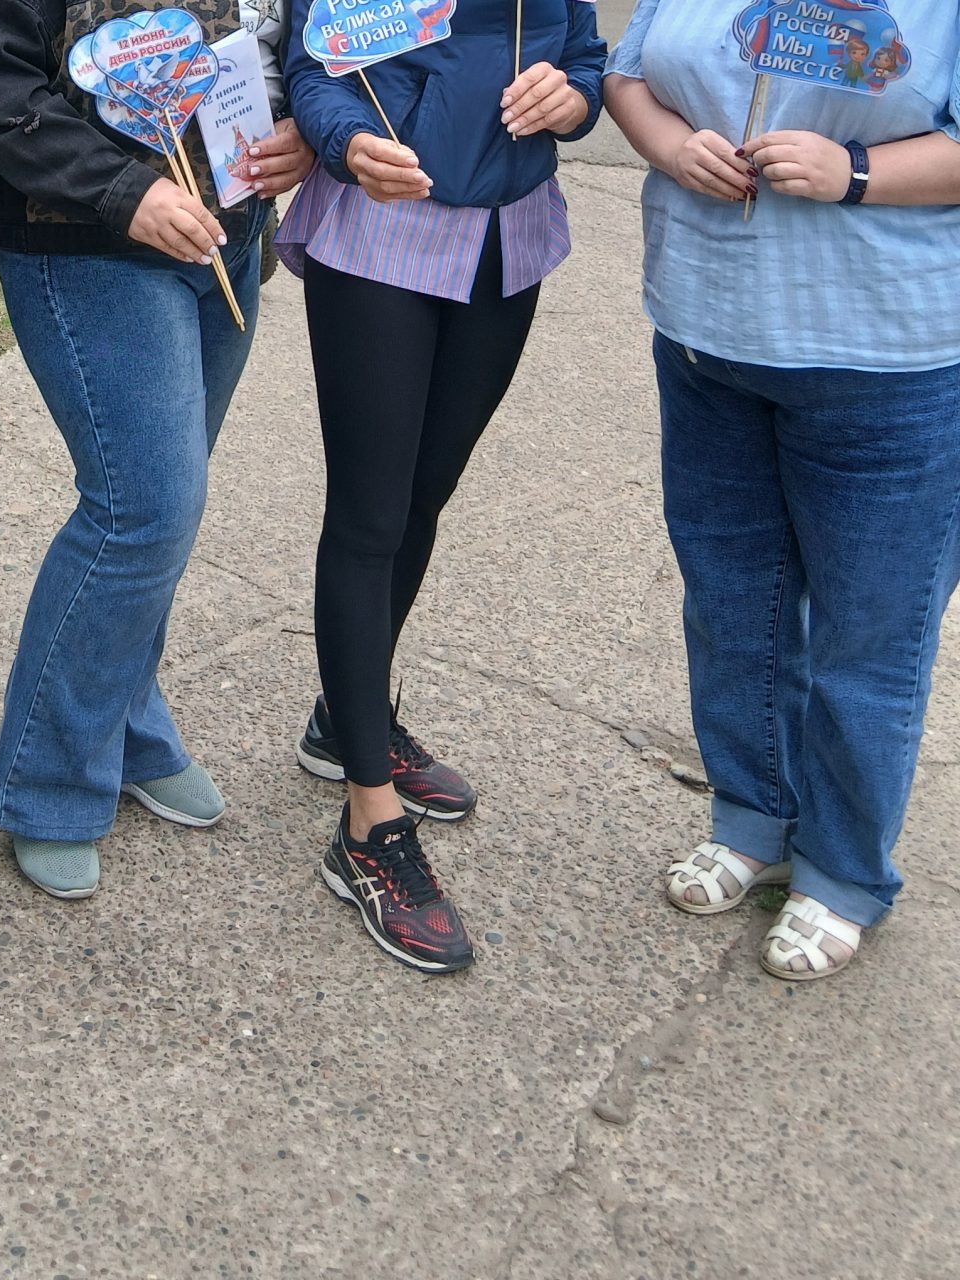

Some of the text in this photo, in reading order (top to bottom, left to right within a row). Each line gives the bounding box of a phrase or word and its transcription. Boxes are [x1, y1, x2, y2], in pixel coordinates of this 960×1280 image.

[795, 0, 835, 23] Мы
[109, 34, 190, 68] ДЕНЬ РОССИИ!
[117, 40, 130, 50] 12
[131, 29, 166, 48] ИЮНЯ
[772, 32, 814, 58] Мы
[215, 79, 247, 100] июня
[218, 95, 244, 113] День
[215, 104, 253, 129] России
